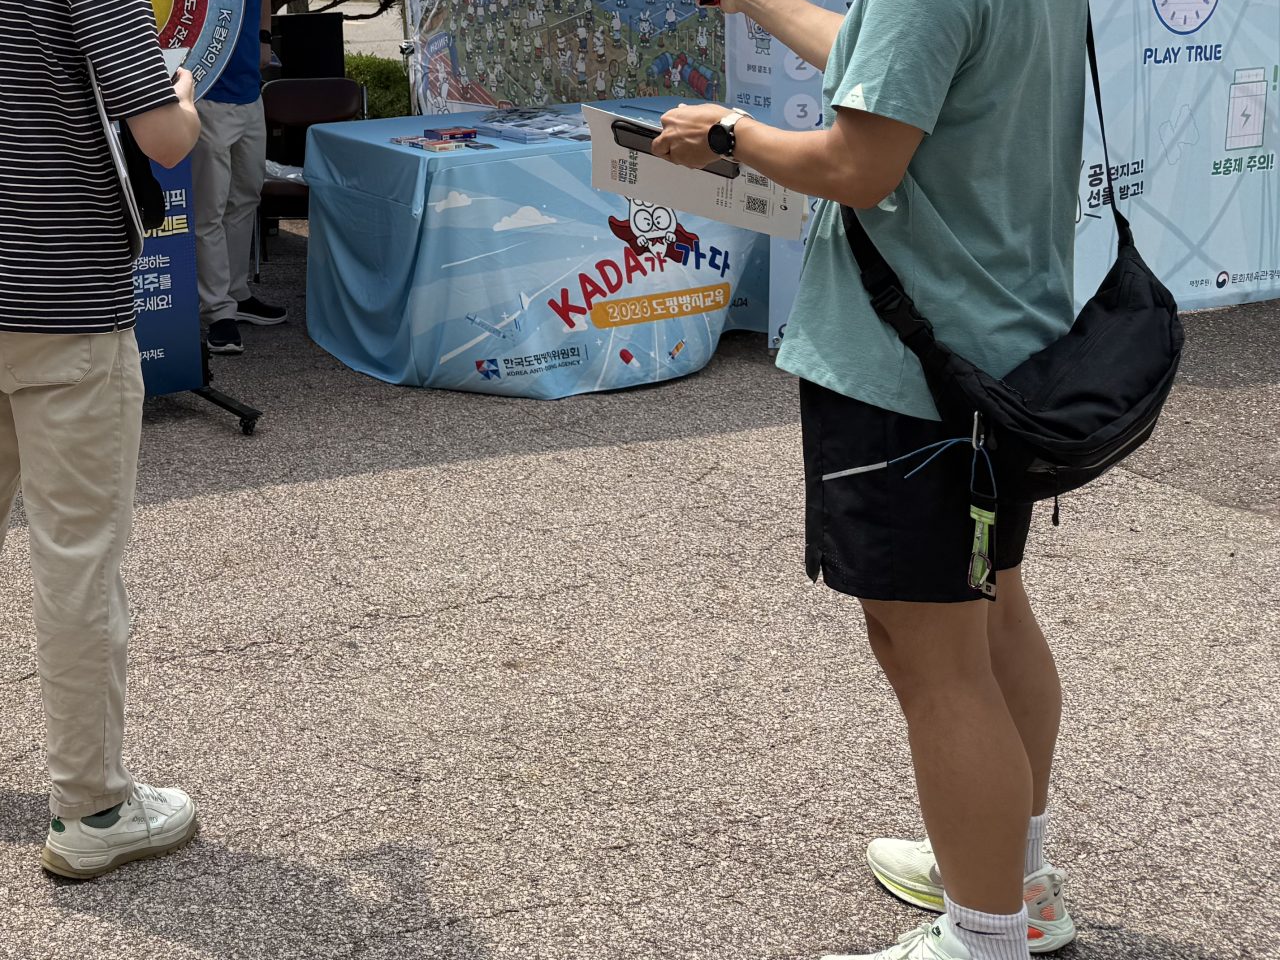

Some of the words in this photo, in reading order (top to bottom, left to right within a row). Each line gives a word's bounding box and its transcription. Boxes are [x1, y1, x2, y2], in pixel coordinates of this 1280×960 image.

[1143, 46, 1182, 65] PLAY
[1185, 44, 1223, 63] TRUE
[796, 103, 808, 119] 3
[1087, 163, 1105, 188] 공
[1211, 156, 1243, 176] 보충제
[1246, 153, 1275, 173] 주의!
[1118, 181, 1145, 201] 받고!
[675, 239, 731, 278] 가다
[606, 302, 651, 323] 2026
[652, 287, 725, 316] 도핑방지교육
[506, 369, 529, 377] KOREA
